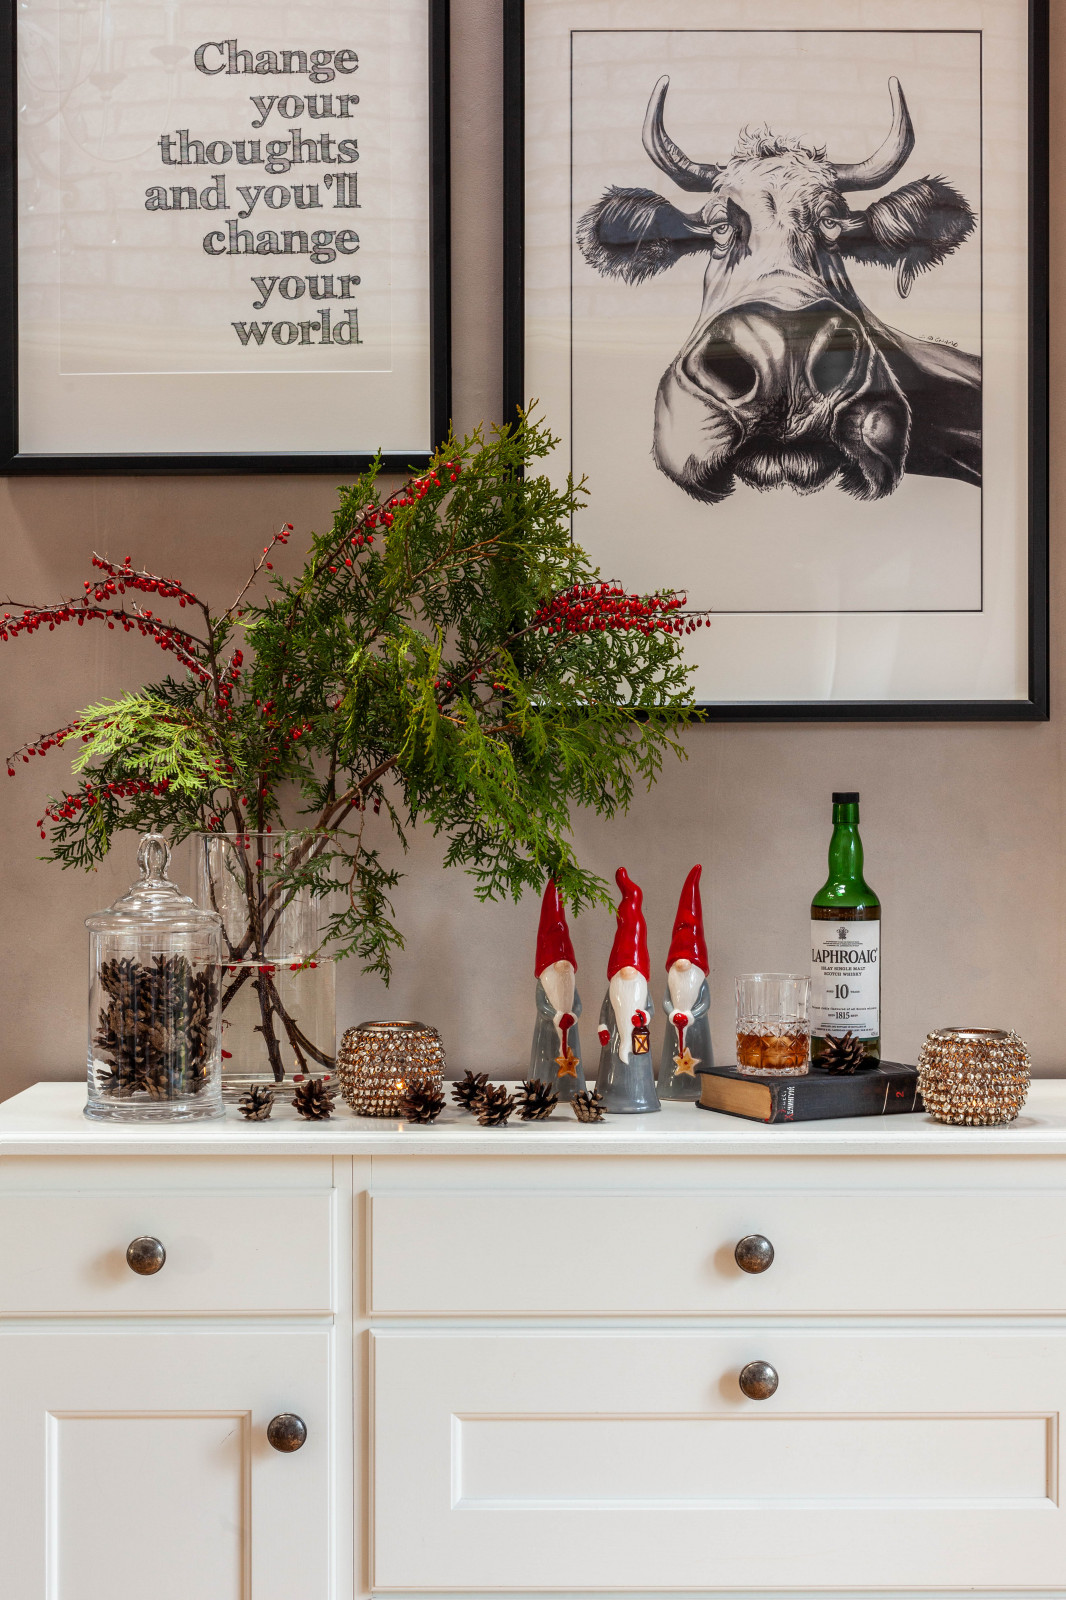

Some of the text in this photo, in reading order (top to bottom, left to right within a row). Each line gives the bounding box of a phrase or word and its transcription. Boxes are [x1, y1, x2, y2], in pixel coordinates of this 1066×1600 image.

[194, 40, 359, 83] Change
[250, 92, 360, 128] your
[158, 129, 360, 174] thoughts
[145, 172, 361, 218] and you'll
[203, 219, 361, 264] change
[251, 274, 361, 309] your
[231, 308, 363, 346] world
[811, 948, 877, 964] LAPHROAIG
[835, 984, 849, 999] 10
[835, 1011, 850, 1020] 1815
